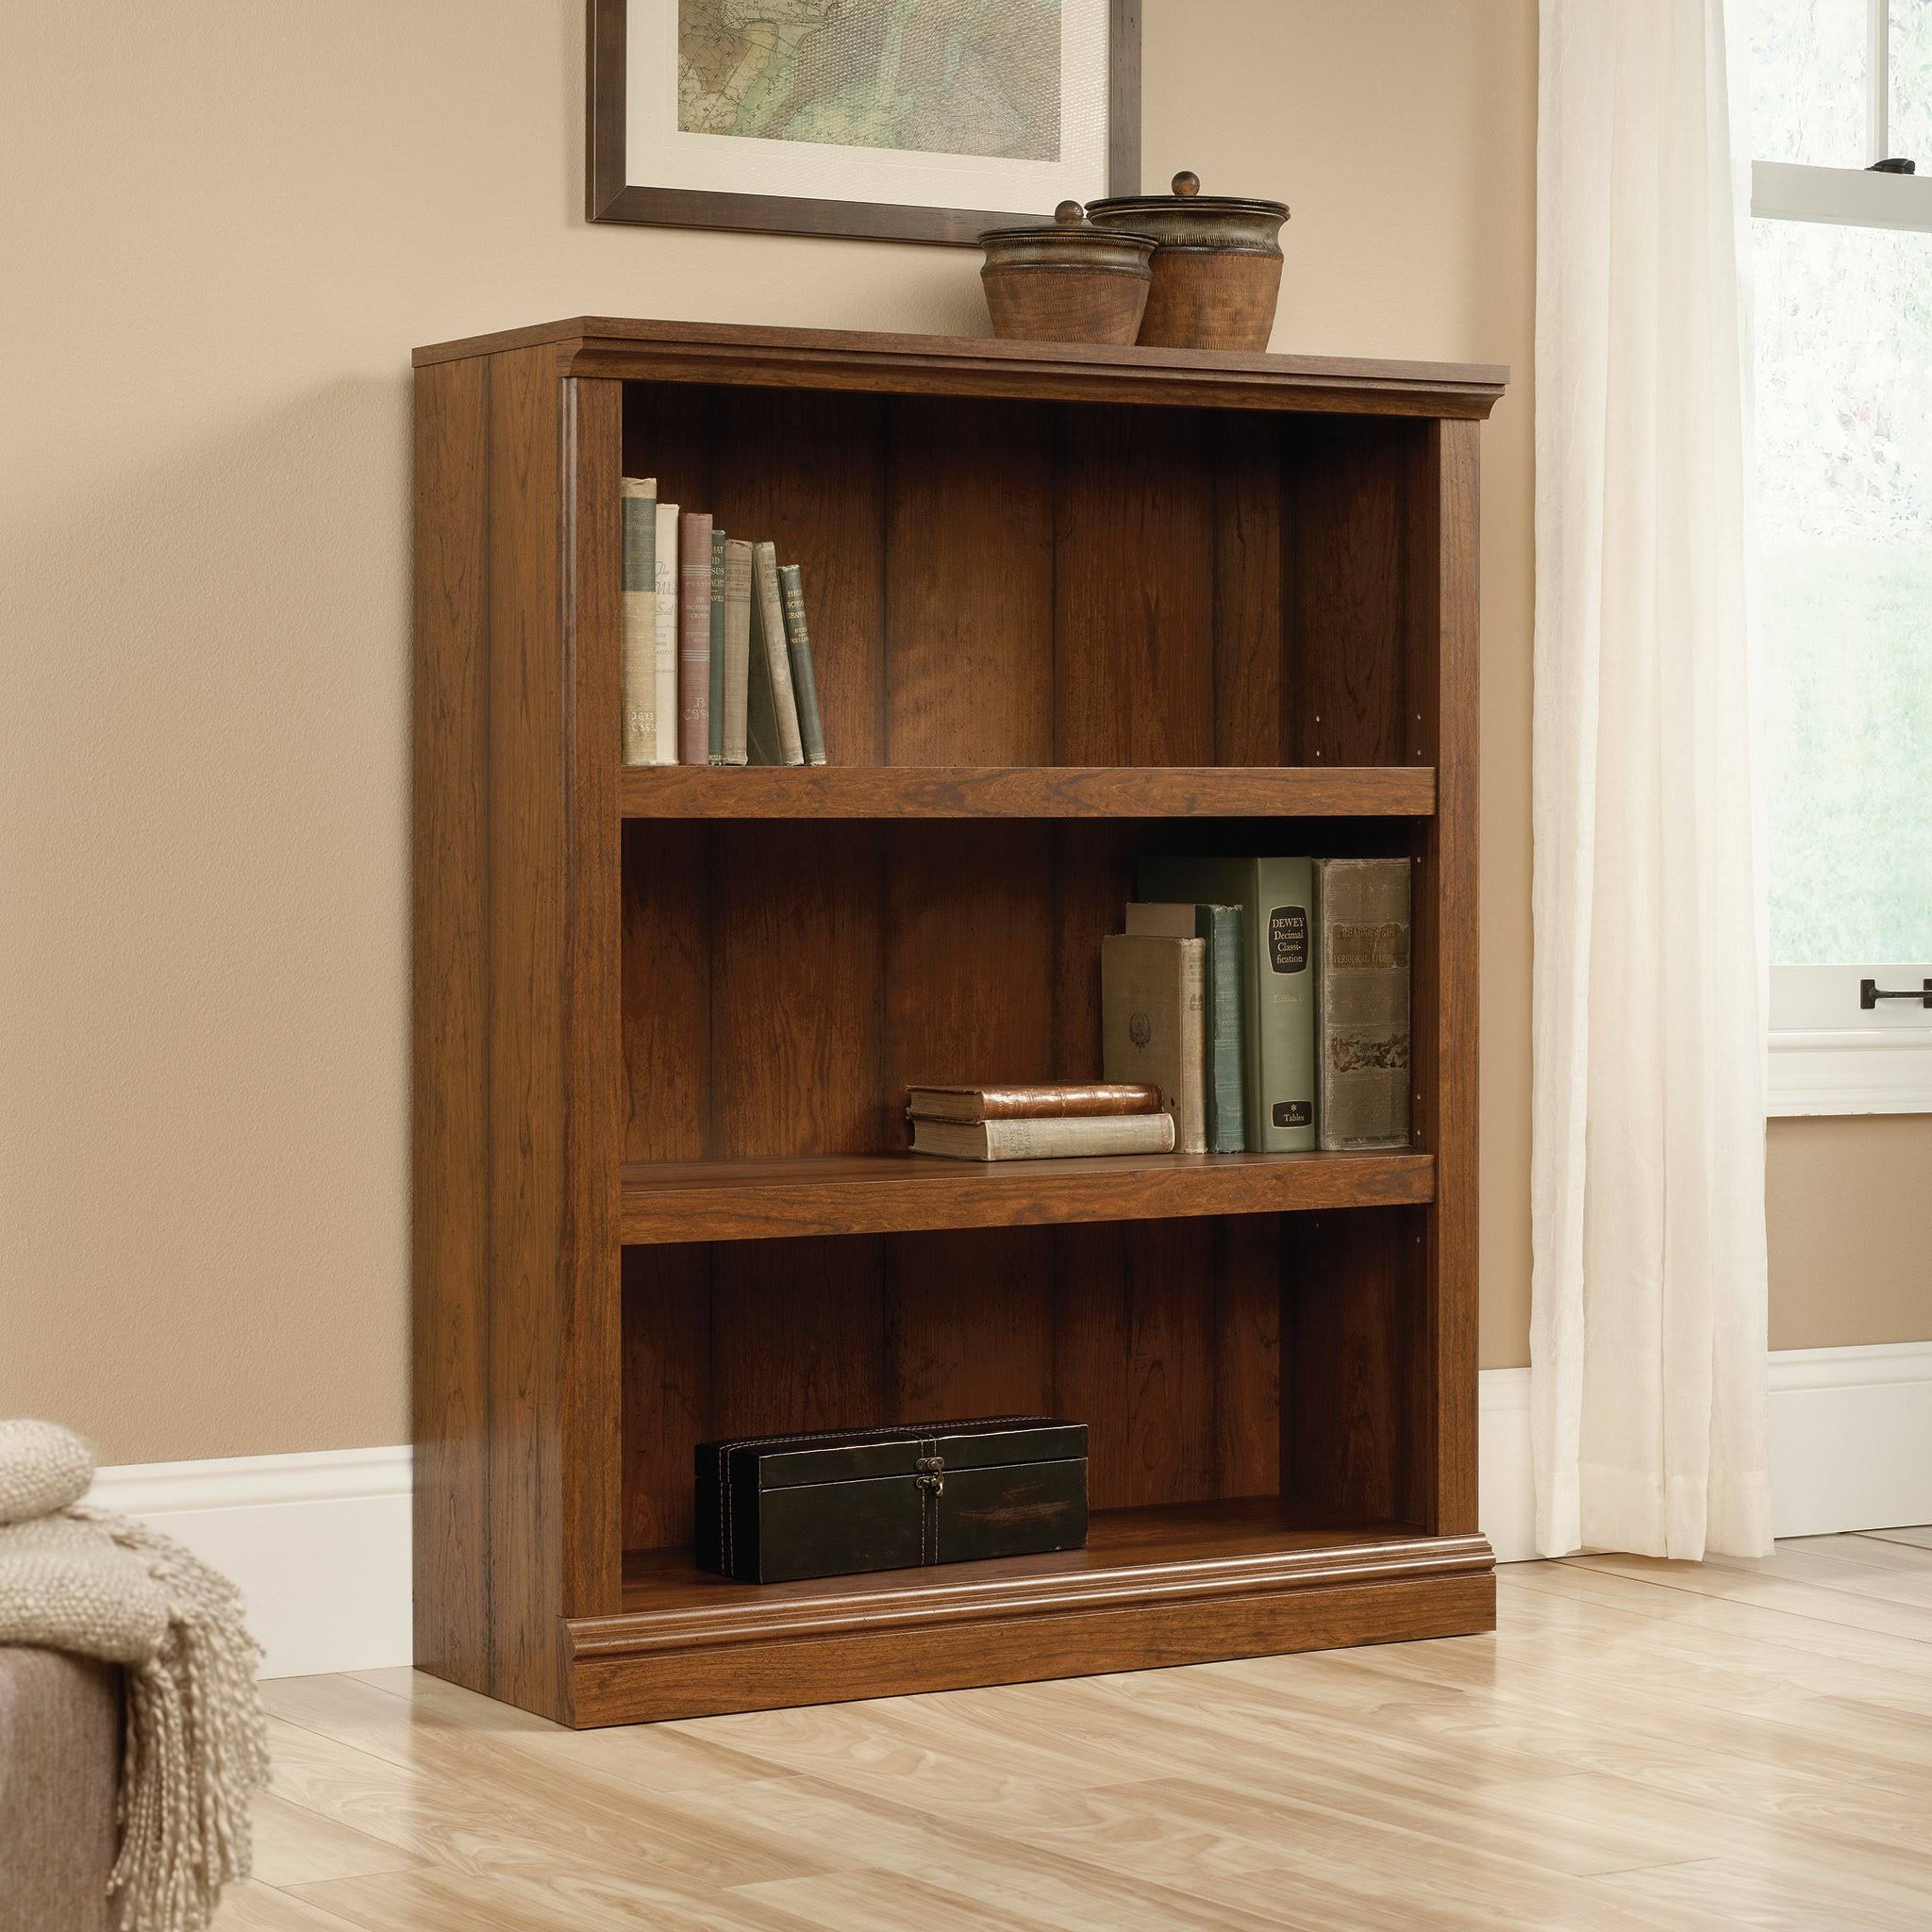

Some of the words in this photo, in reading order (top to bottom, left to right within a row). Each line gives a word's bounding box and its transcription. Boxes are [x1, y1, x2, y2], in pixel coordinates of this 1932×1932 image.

[711, 567, 724, 575] SUS
[787, 589, 803, 597] HIG
[1273, 918, 1305, 928] DEWEY
[1274, 929, 1304, 941] Decimal
[1277, 941, 1302, 952] Classi-
[1276, 954, 1303, 964] fication
[1284, 1113, 1305, 1122] Tables
